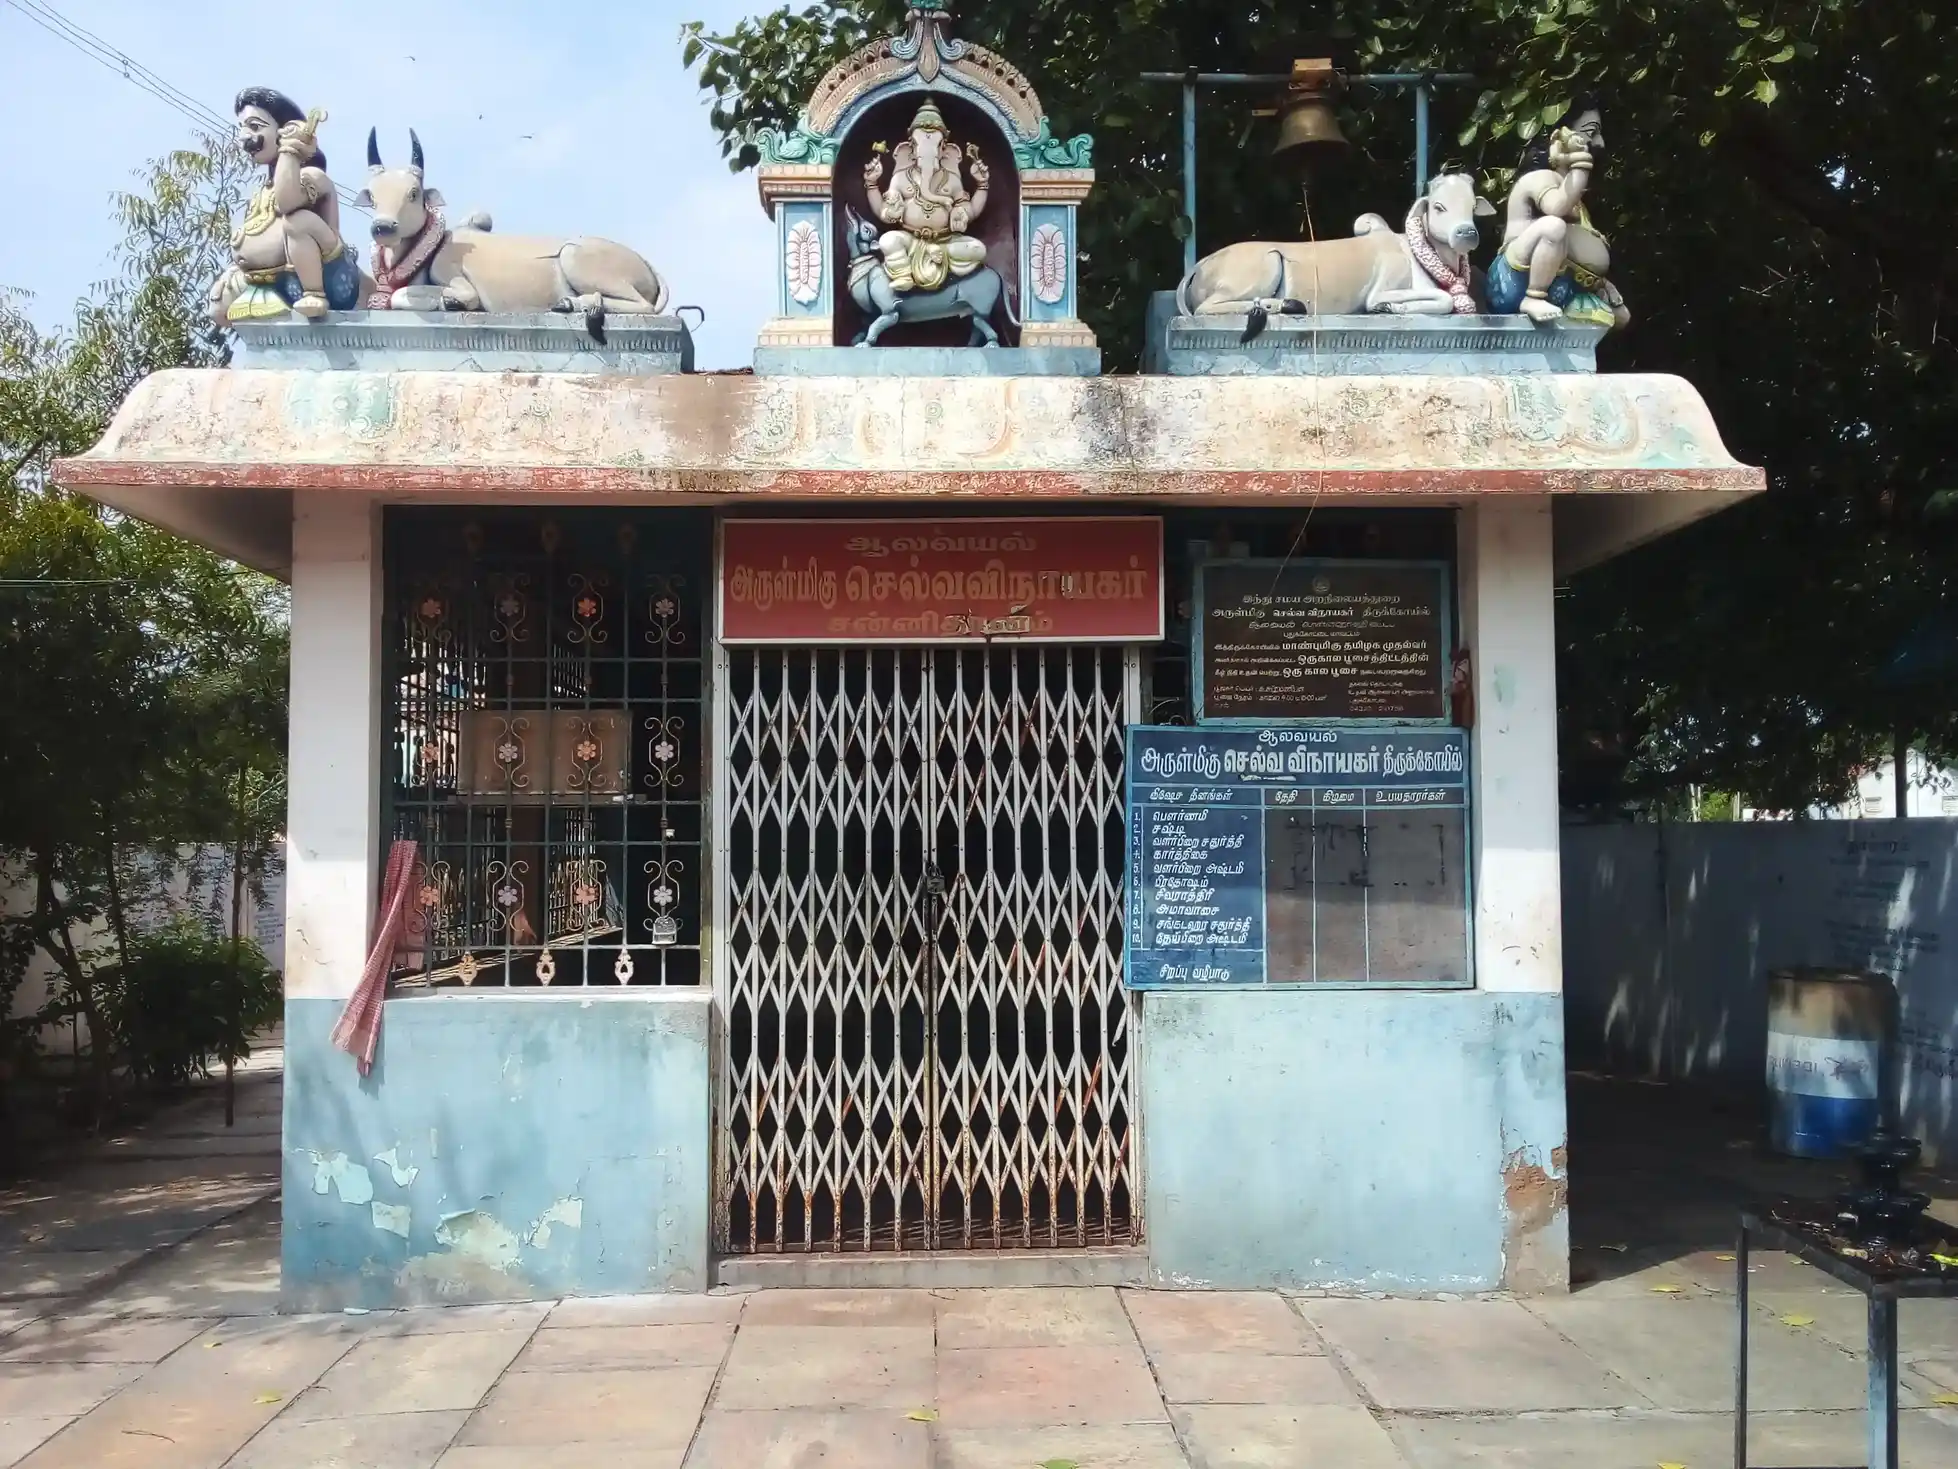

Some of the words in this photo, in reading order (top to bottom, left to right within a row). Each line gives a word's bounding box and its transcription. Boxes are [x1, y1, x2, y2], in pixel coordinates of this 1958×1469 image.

[731, 556, 838, 611] அருள்மிகு
[1275, 595, 1300, 604] சமய
[1212, 606, 1265, 619] அருள்மிகு
[1273, 607, 1305, 617] செல்வ
[1307, 606, 1354, 618] விநாயகர்
[1362, 605, 1431, 618] திருக்கோயில்
[1282, 640, 1341, 651] மாண்புமிகு
[1344, 640, 1380, 652] தமிழக
[1382, 639, 1427, 652] முதல்வர்
[1282, 667, 1302, 678] ஒரு
[1304, 667, 1329, 675] கால
[1330, 667, 1358, 678] பூசை
[1258, 729, 1337, 747] ஆலவயல்
[1140, 744, 1221, 779] அருள்மிகு
[1224, 744, 1284, 773] செல்வ
[1288, 744, 1380, 774] விநாயகர்
[1383, 744, 1463, 777] திருக்கோயில்
[1188, 786, 1233, 802] தினங்கள்
[1274, 789, 1298, 805] தேதி
[1322, 789, 1355, 804] கிழமை
[1152, 822, 1186, 836] சஷ்டி
[1152, 834, 1199, 848] வளர்பிறை
[1201, 834, 1245, 849] சதுர்த்தி
[1153, 847, 1208, 861] கார்த்திகை
[1153, 861, 1201, 875] வளர்பிறை
[1205, 861, 1245, 876] அஷ்டமி
[1154, 874, 1209, 889] பிரதோஷம்
[1155, 888, 1216, 903] சிவராத்திரி
[1156, 904, 1220, 915] அமாவாசை
[1210, 916, 1252, 932] சதுர்த்தி
[1206, 931, 1249, 946] அஷ்டமி
[1159, 963, 1188, 980] சிறப்பு
[1192, 964, 1230, 980] வழிபாடு
